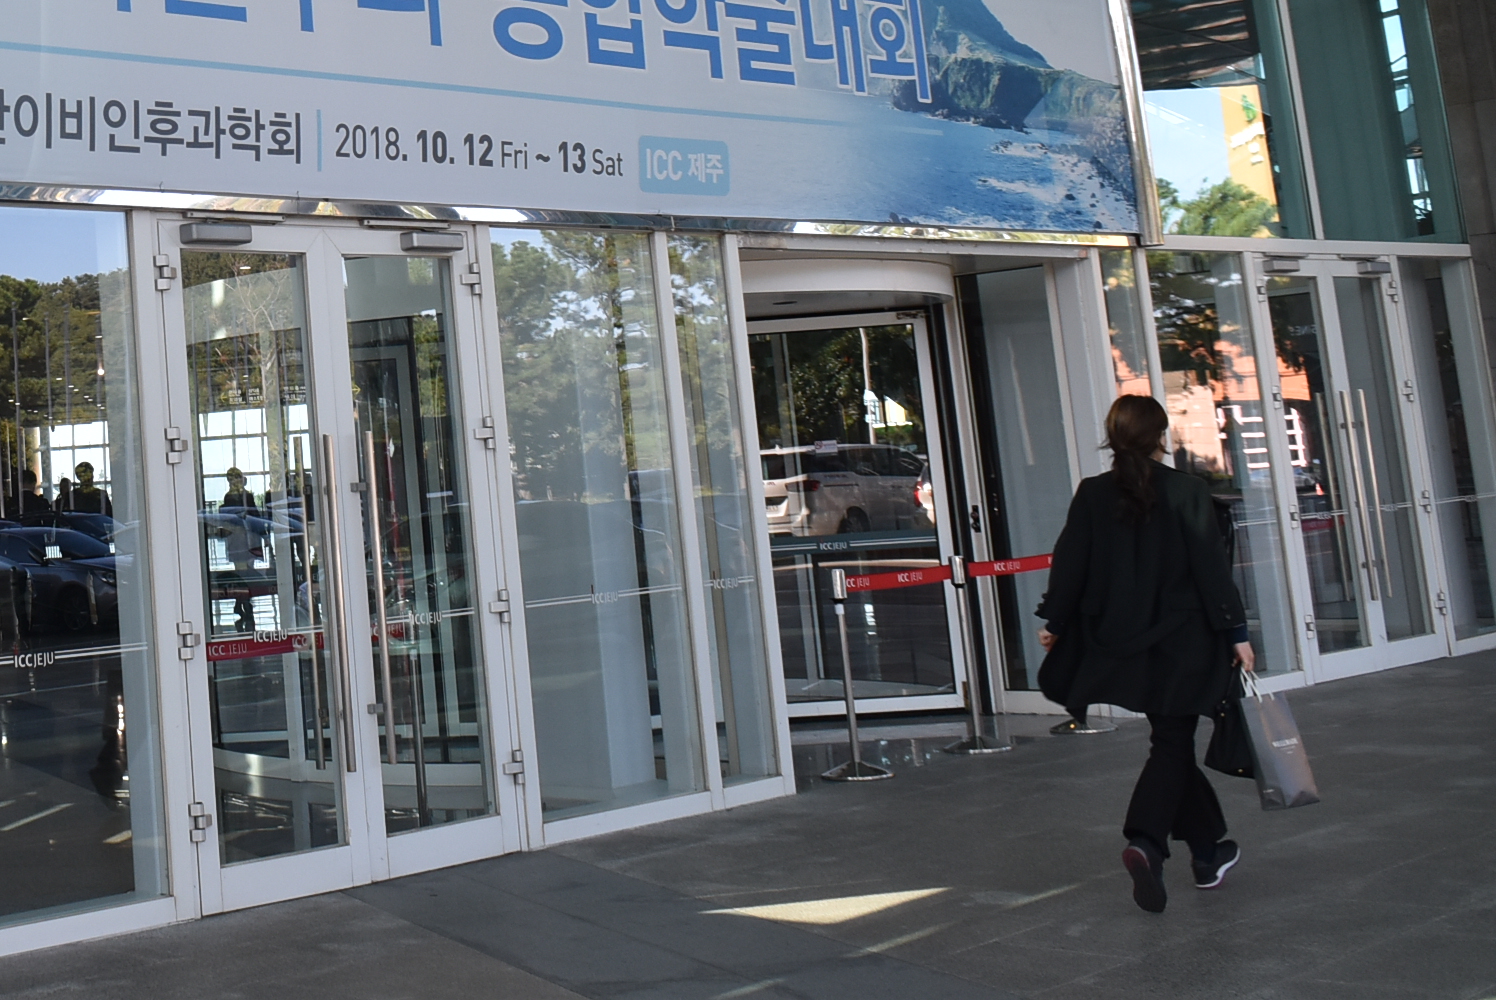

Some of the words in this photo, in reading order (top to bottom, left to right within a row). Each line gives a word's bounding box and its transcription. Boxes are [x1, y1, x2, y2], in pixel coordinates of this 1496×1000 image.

[335, 122, 409, 162] 2018.
[416, 128, 456, 165] 10.
[645, 148, 683, 181] ICC
[687, 154, 725, 184] 제주
[994, 561, 1006, 572] ICC
[897, 572, 910, 583] ICC
[208, 644, 226, 656] ICC
[228, 642, 248, 655] JEJU
